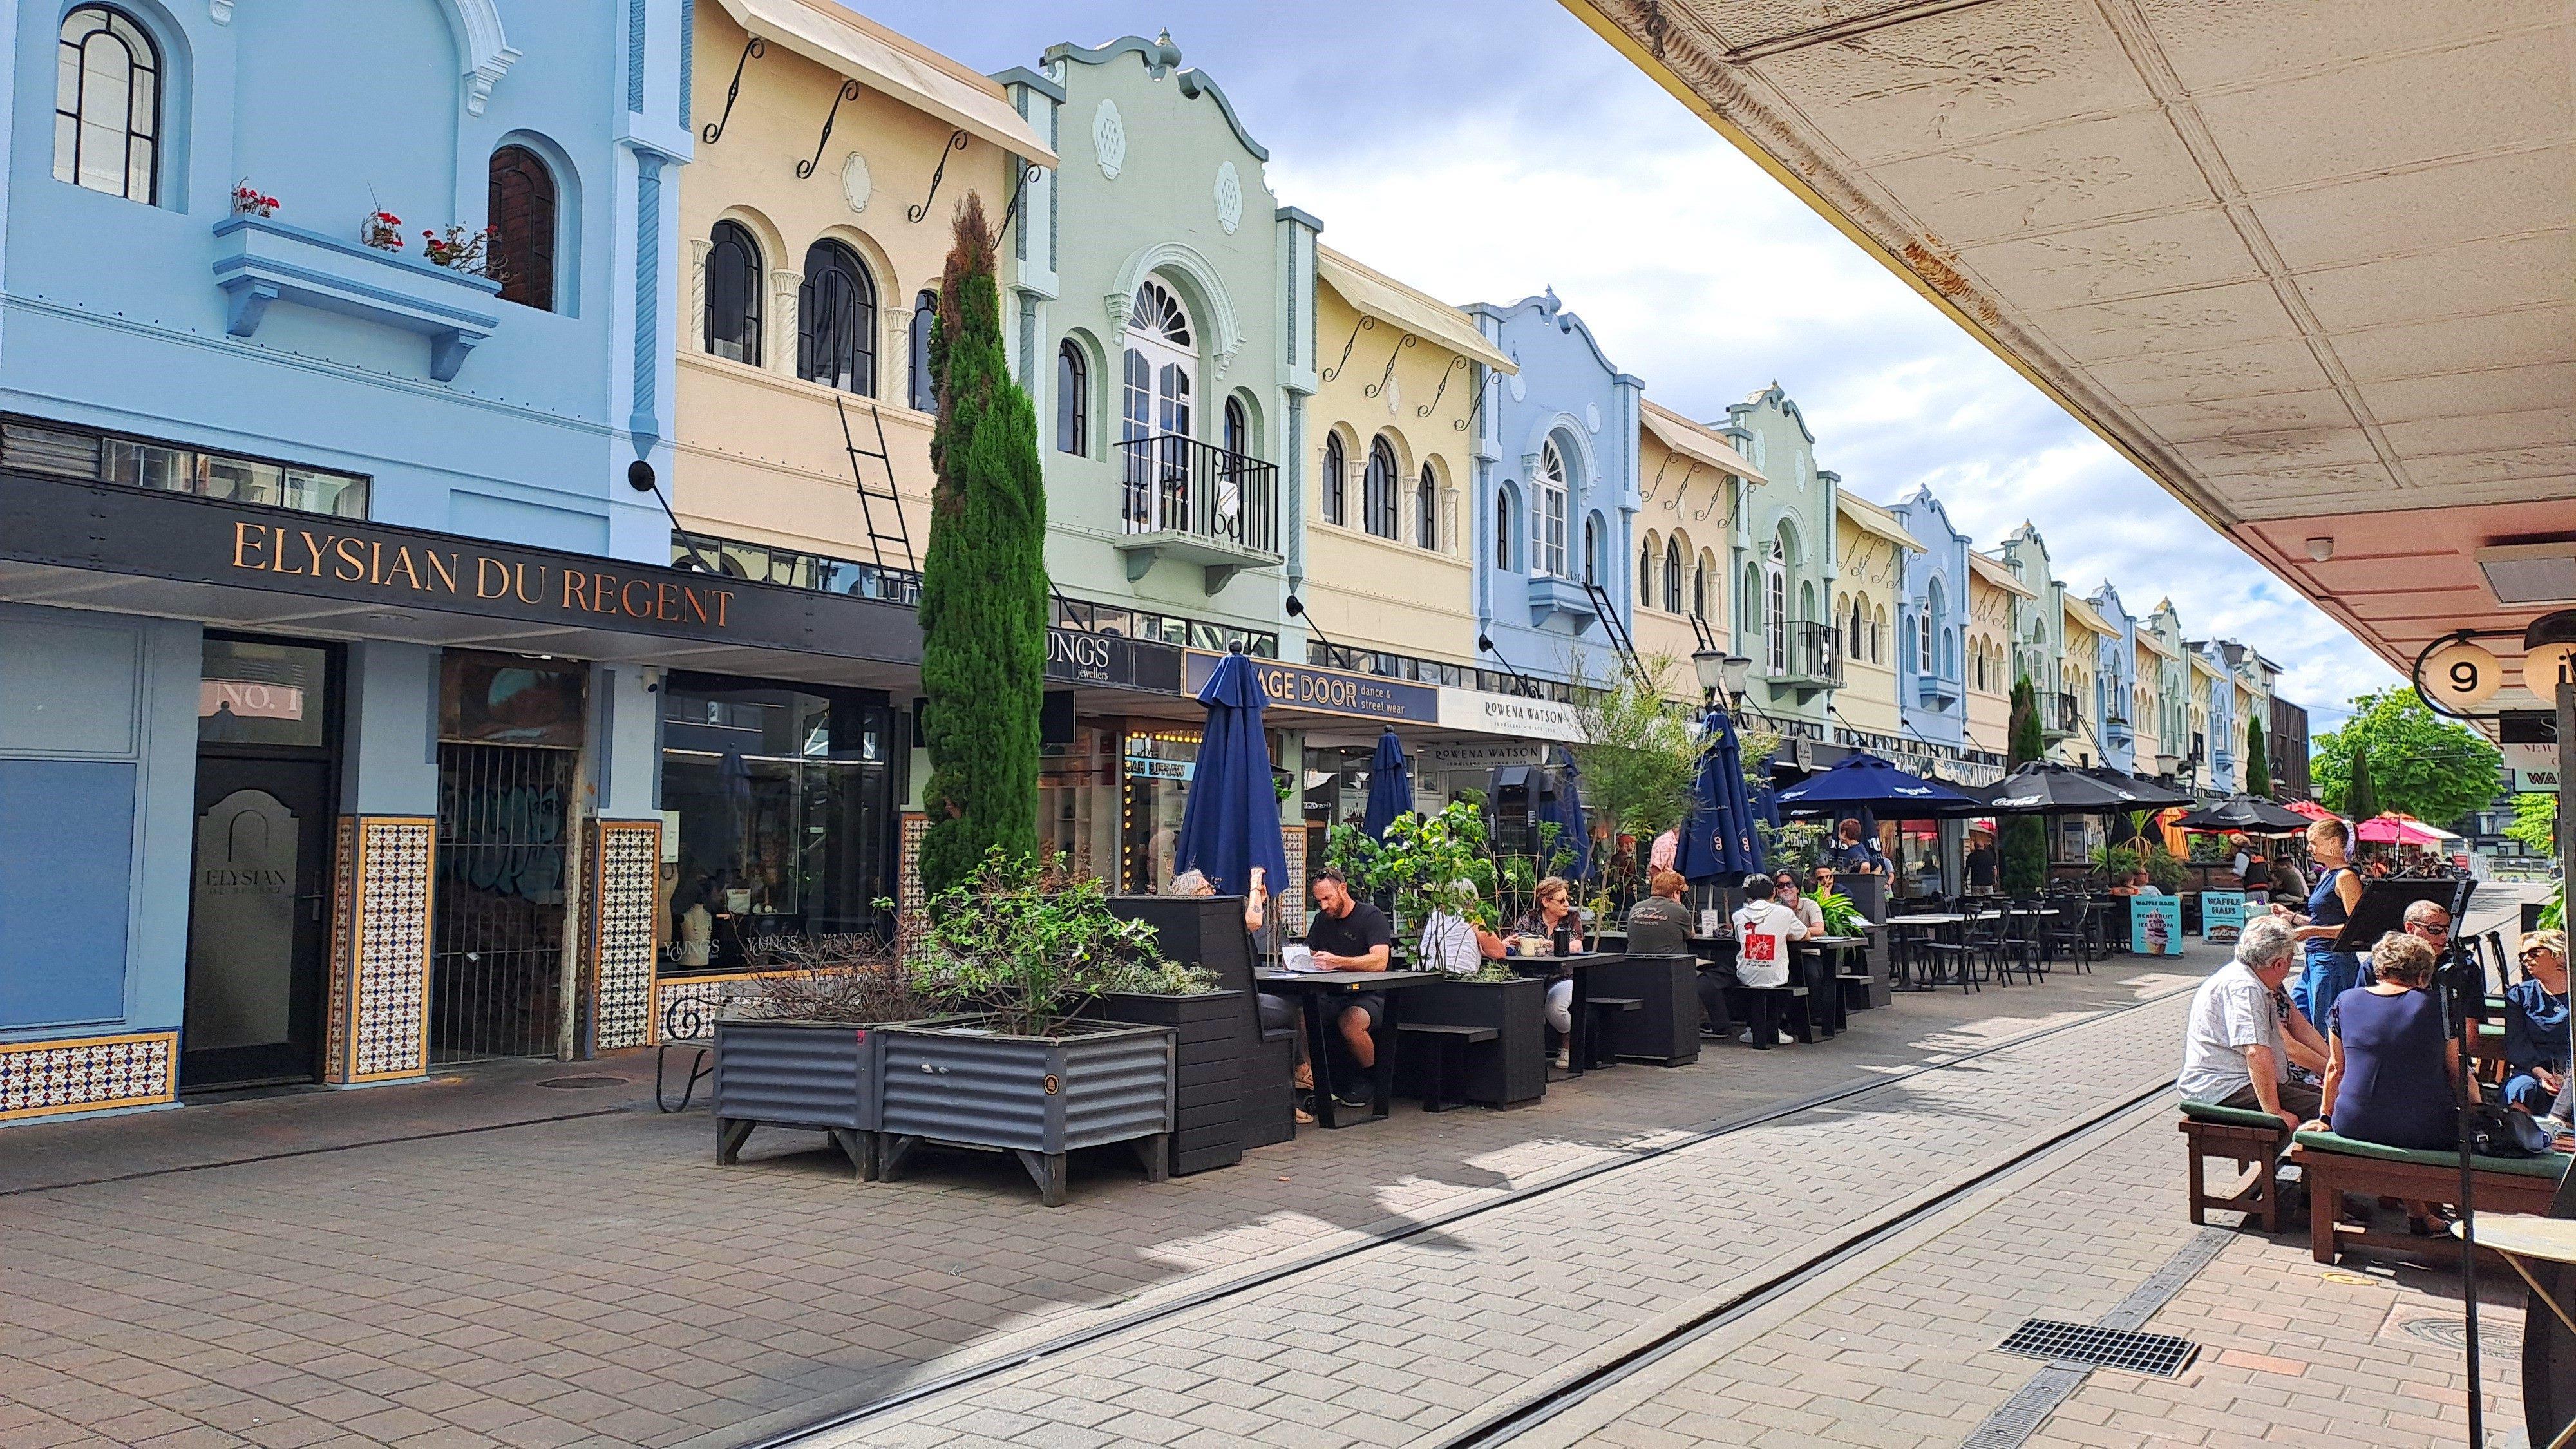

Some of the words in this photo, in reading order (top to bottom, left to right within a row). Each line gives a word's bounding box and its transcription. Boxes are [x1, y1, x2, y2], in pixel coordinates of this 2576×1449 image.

[232, 521, 459, 594] ELYSIAN
[476, 557, 546, 605] DU
[562, 569, 735, 628] REGENT
[1077, 665, 1109, 681] jewellers
[215, 684, 276, 709] NO.
[1300, 674, 1357, 708] DOOR
[1361, 684, 1384, 697] dance
[1386, 689, 1392, 699] &
[1361, 699, 1384, 712] street
[1386, 703, 1405, 714] wear
[1485, 702, 1524, 719] ROWENA
[1527, 708, 1563, 724] WATSON
[1435, 749, 1484, 761] ROWENA
[1488, 747, 1538, 757] WATSON
[2207, 898, 2241, 906] WAFFLE
